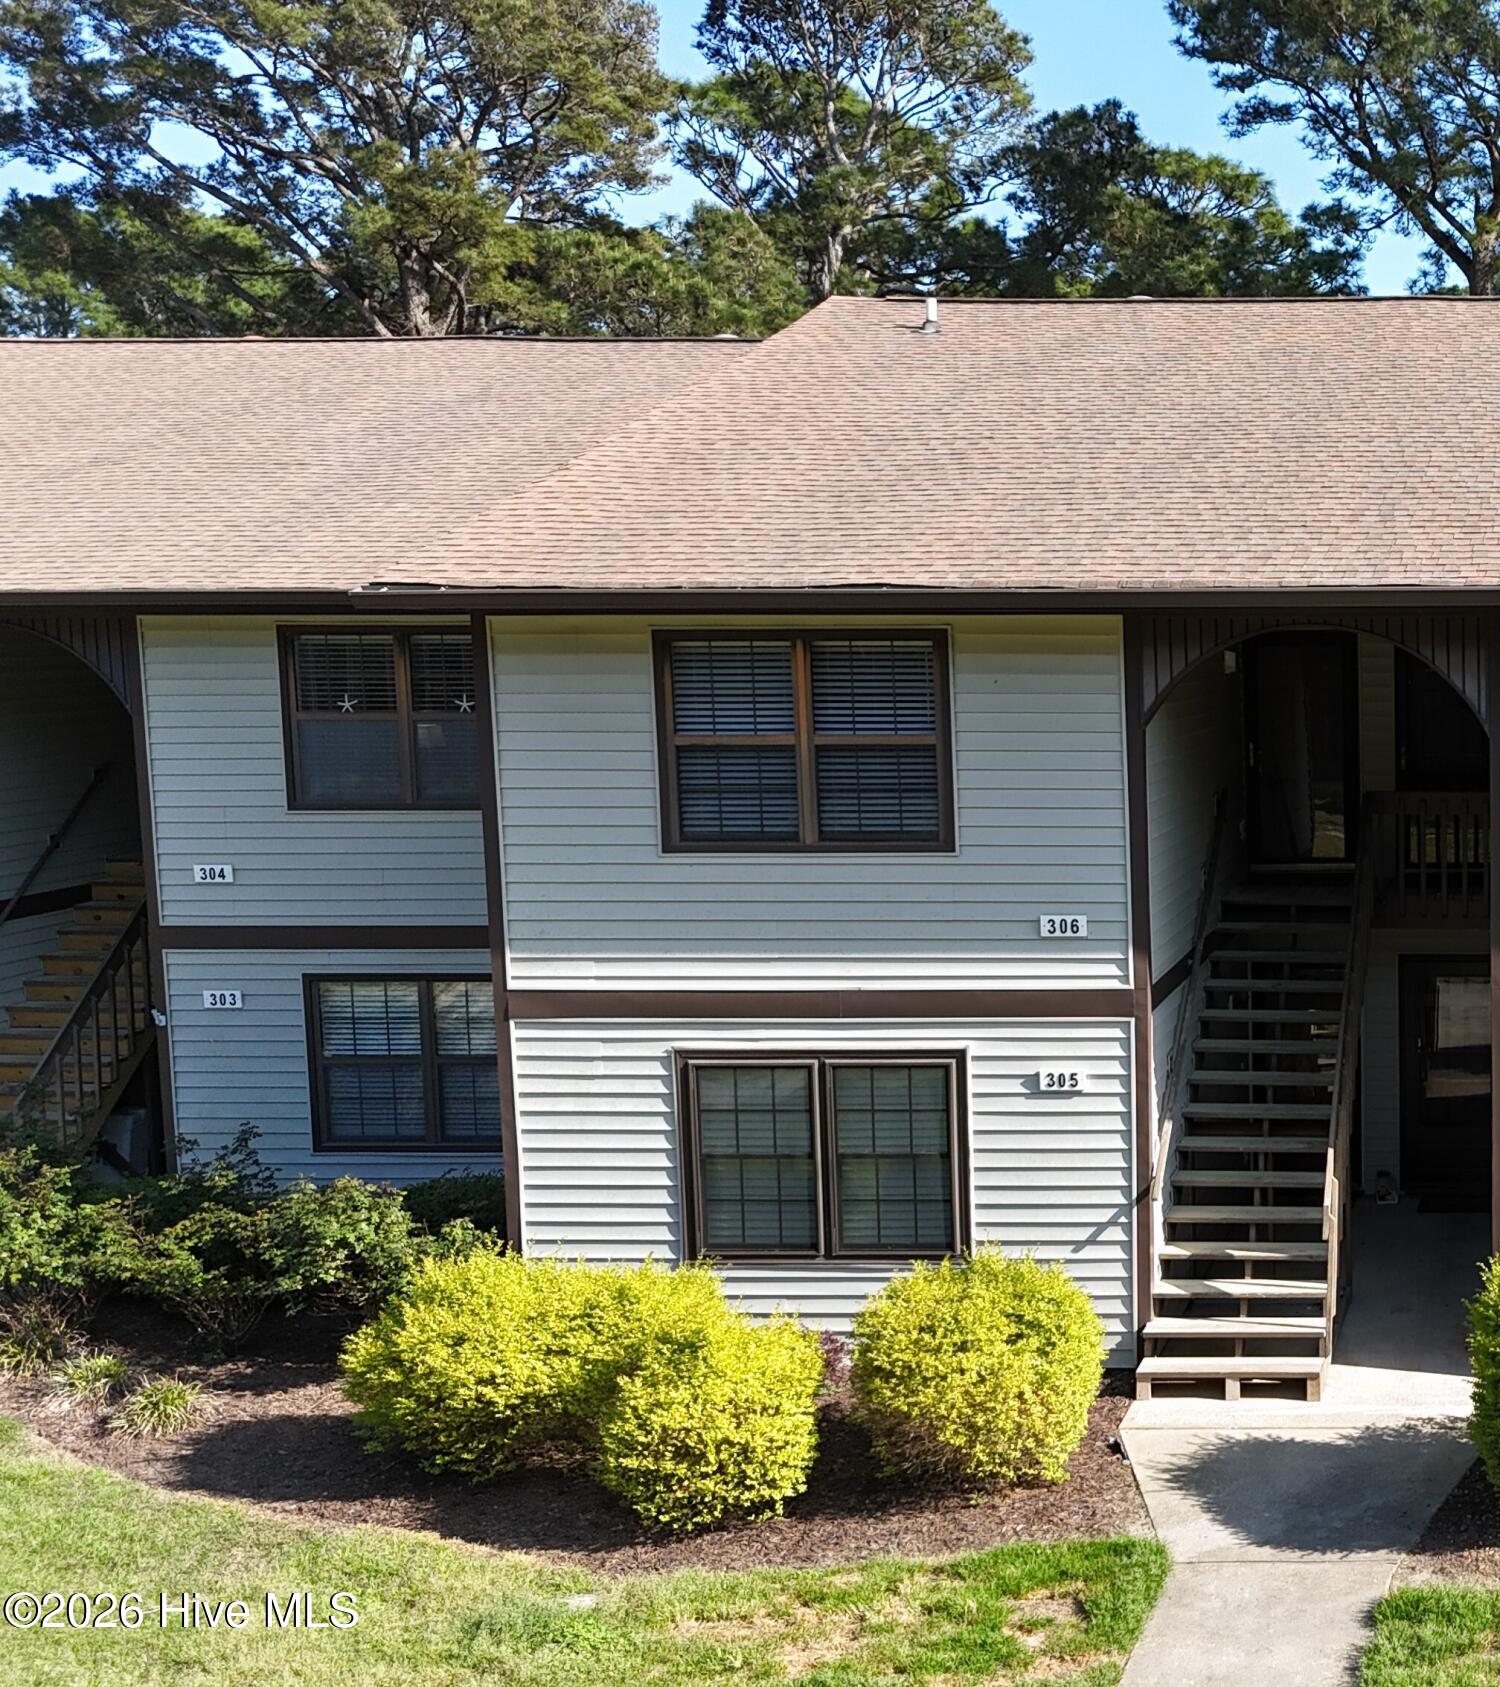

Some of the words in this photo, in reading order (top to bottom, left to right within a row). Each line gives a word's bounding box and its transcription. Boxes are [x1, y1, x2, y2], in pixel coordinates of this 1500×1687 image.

[199, 867, 226, 880] 304
[1047, 918, 1080, 934] 306
[210, 993, 237, 1006] 303
[1045, 1072, 1079, 1088] 305
